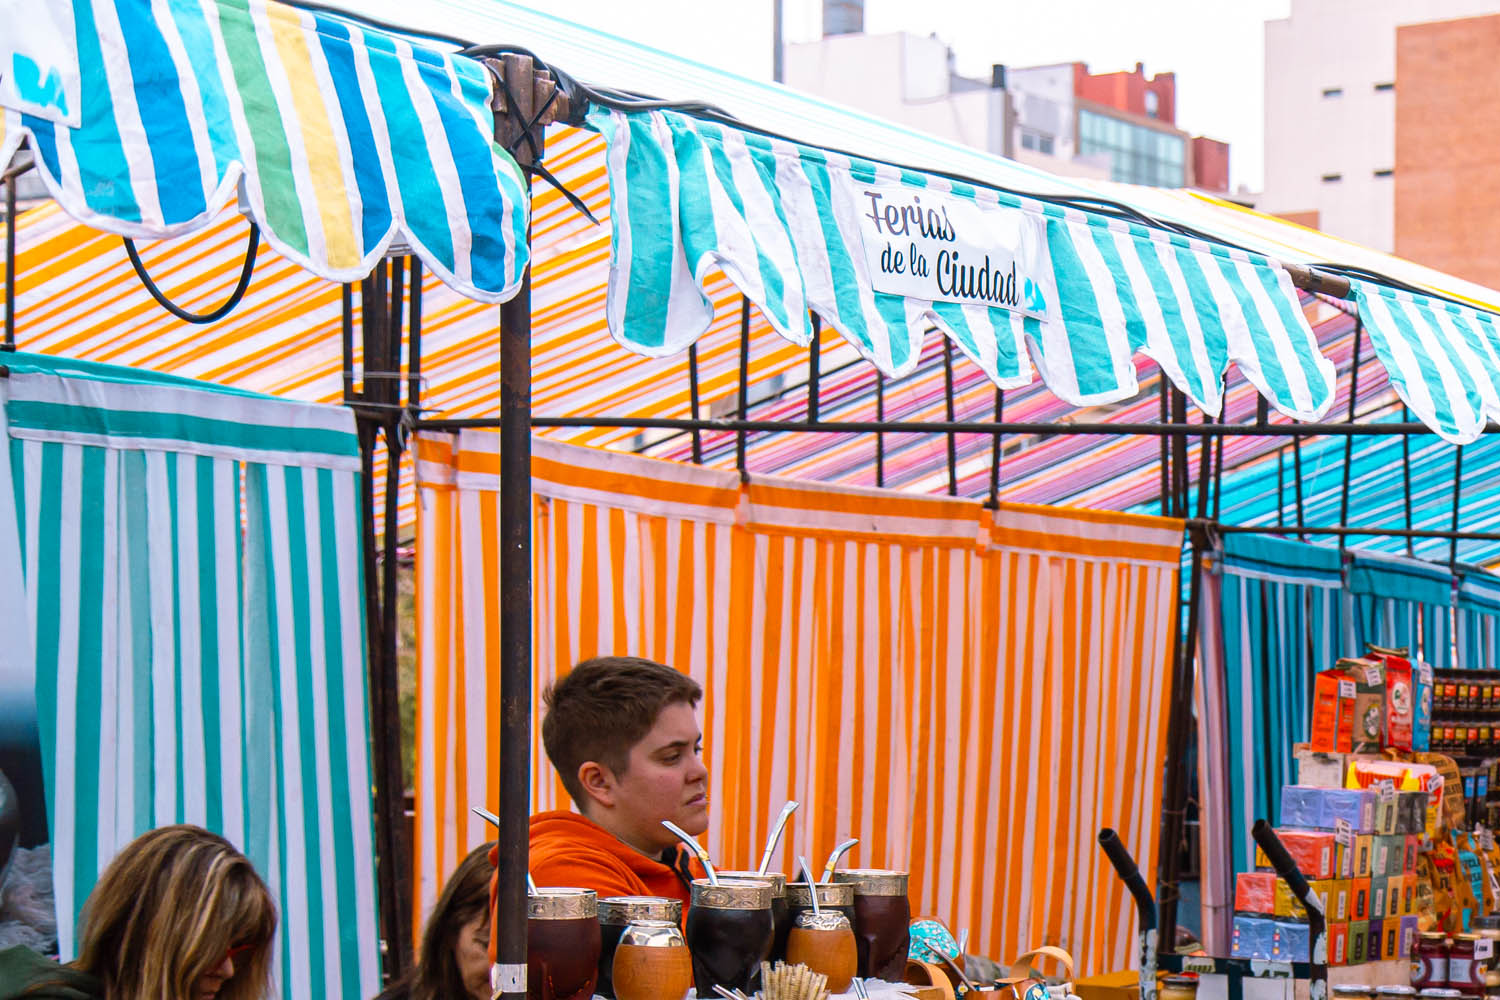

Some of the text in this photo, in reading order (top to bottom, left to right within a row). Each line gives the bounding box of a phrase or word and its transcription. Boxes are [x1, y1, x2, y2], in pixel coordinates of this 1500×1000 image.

[864, 191, 956, 242] Ferias
[881, 241, 1020, 307] de la Ciudad
